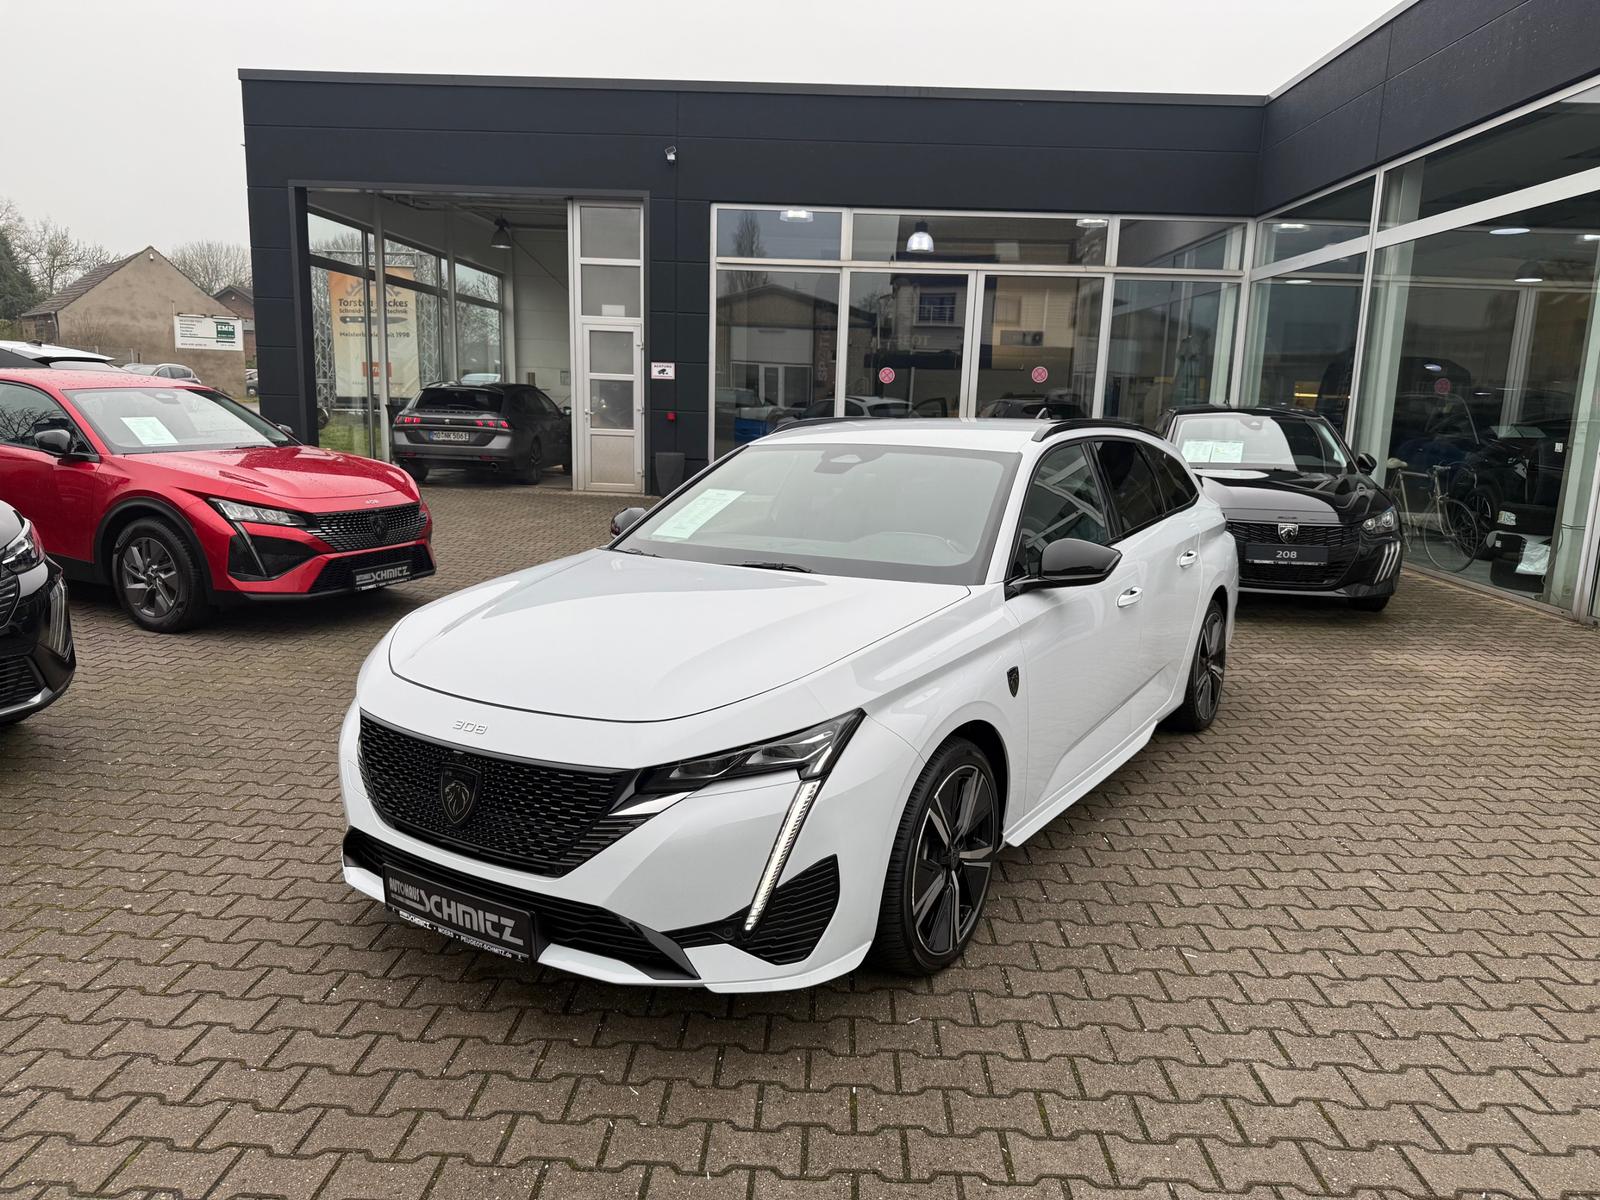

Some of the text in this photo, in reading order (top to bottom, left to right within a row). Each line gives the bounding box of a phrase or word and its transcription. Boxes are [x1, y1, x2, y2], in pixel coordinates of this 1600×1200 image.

[1276, 551, 1297, 559] 208
[452, 720, 488, 735] 308
[389, 878, 524, 946] AUTOHAUS SCHMITZ
[438, 926, 454, 938] MOERS
